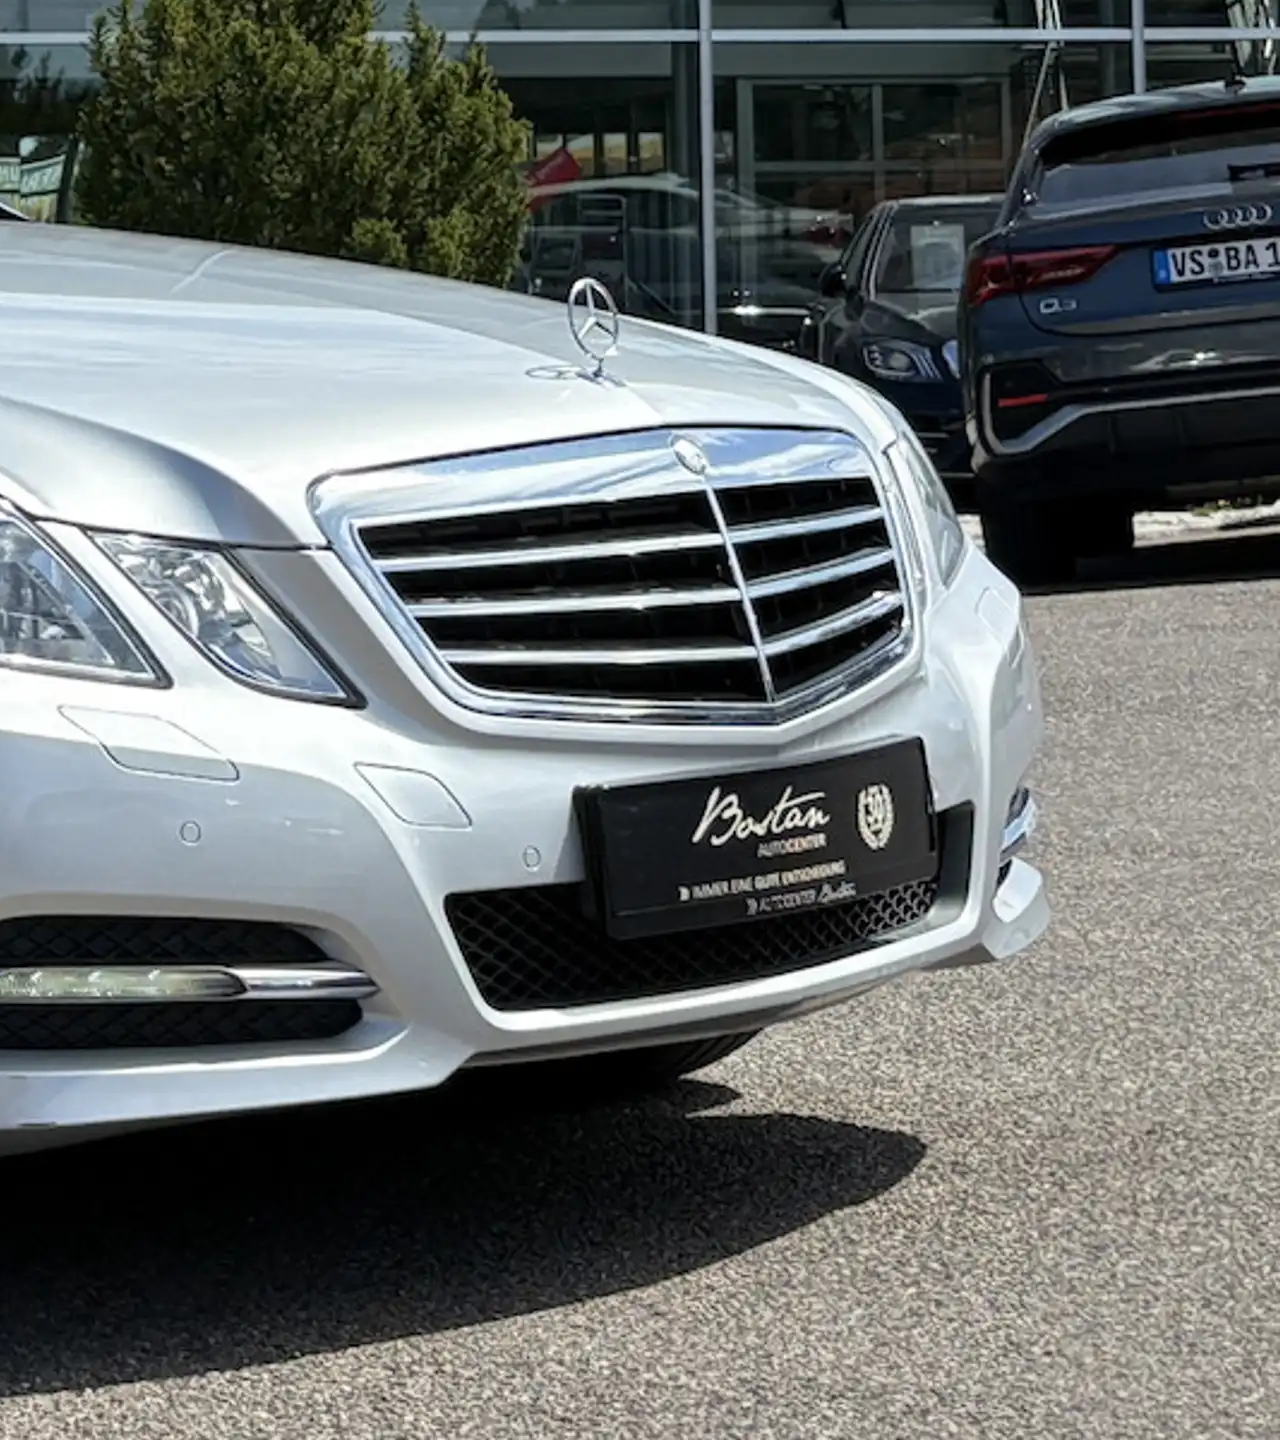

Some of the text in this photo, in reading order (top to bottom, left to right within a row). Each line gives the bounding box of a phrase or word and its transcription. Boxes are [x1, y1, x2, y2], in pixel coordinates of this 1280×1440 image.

[1171, 250, 1205, 277] VS
[1225, 244, 1259, 270] BA
[692, 786, 831, 846] Bostan
